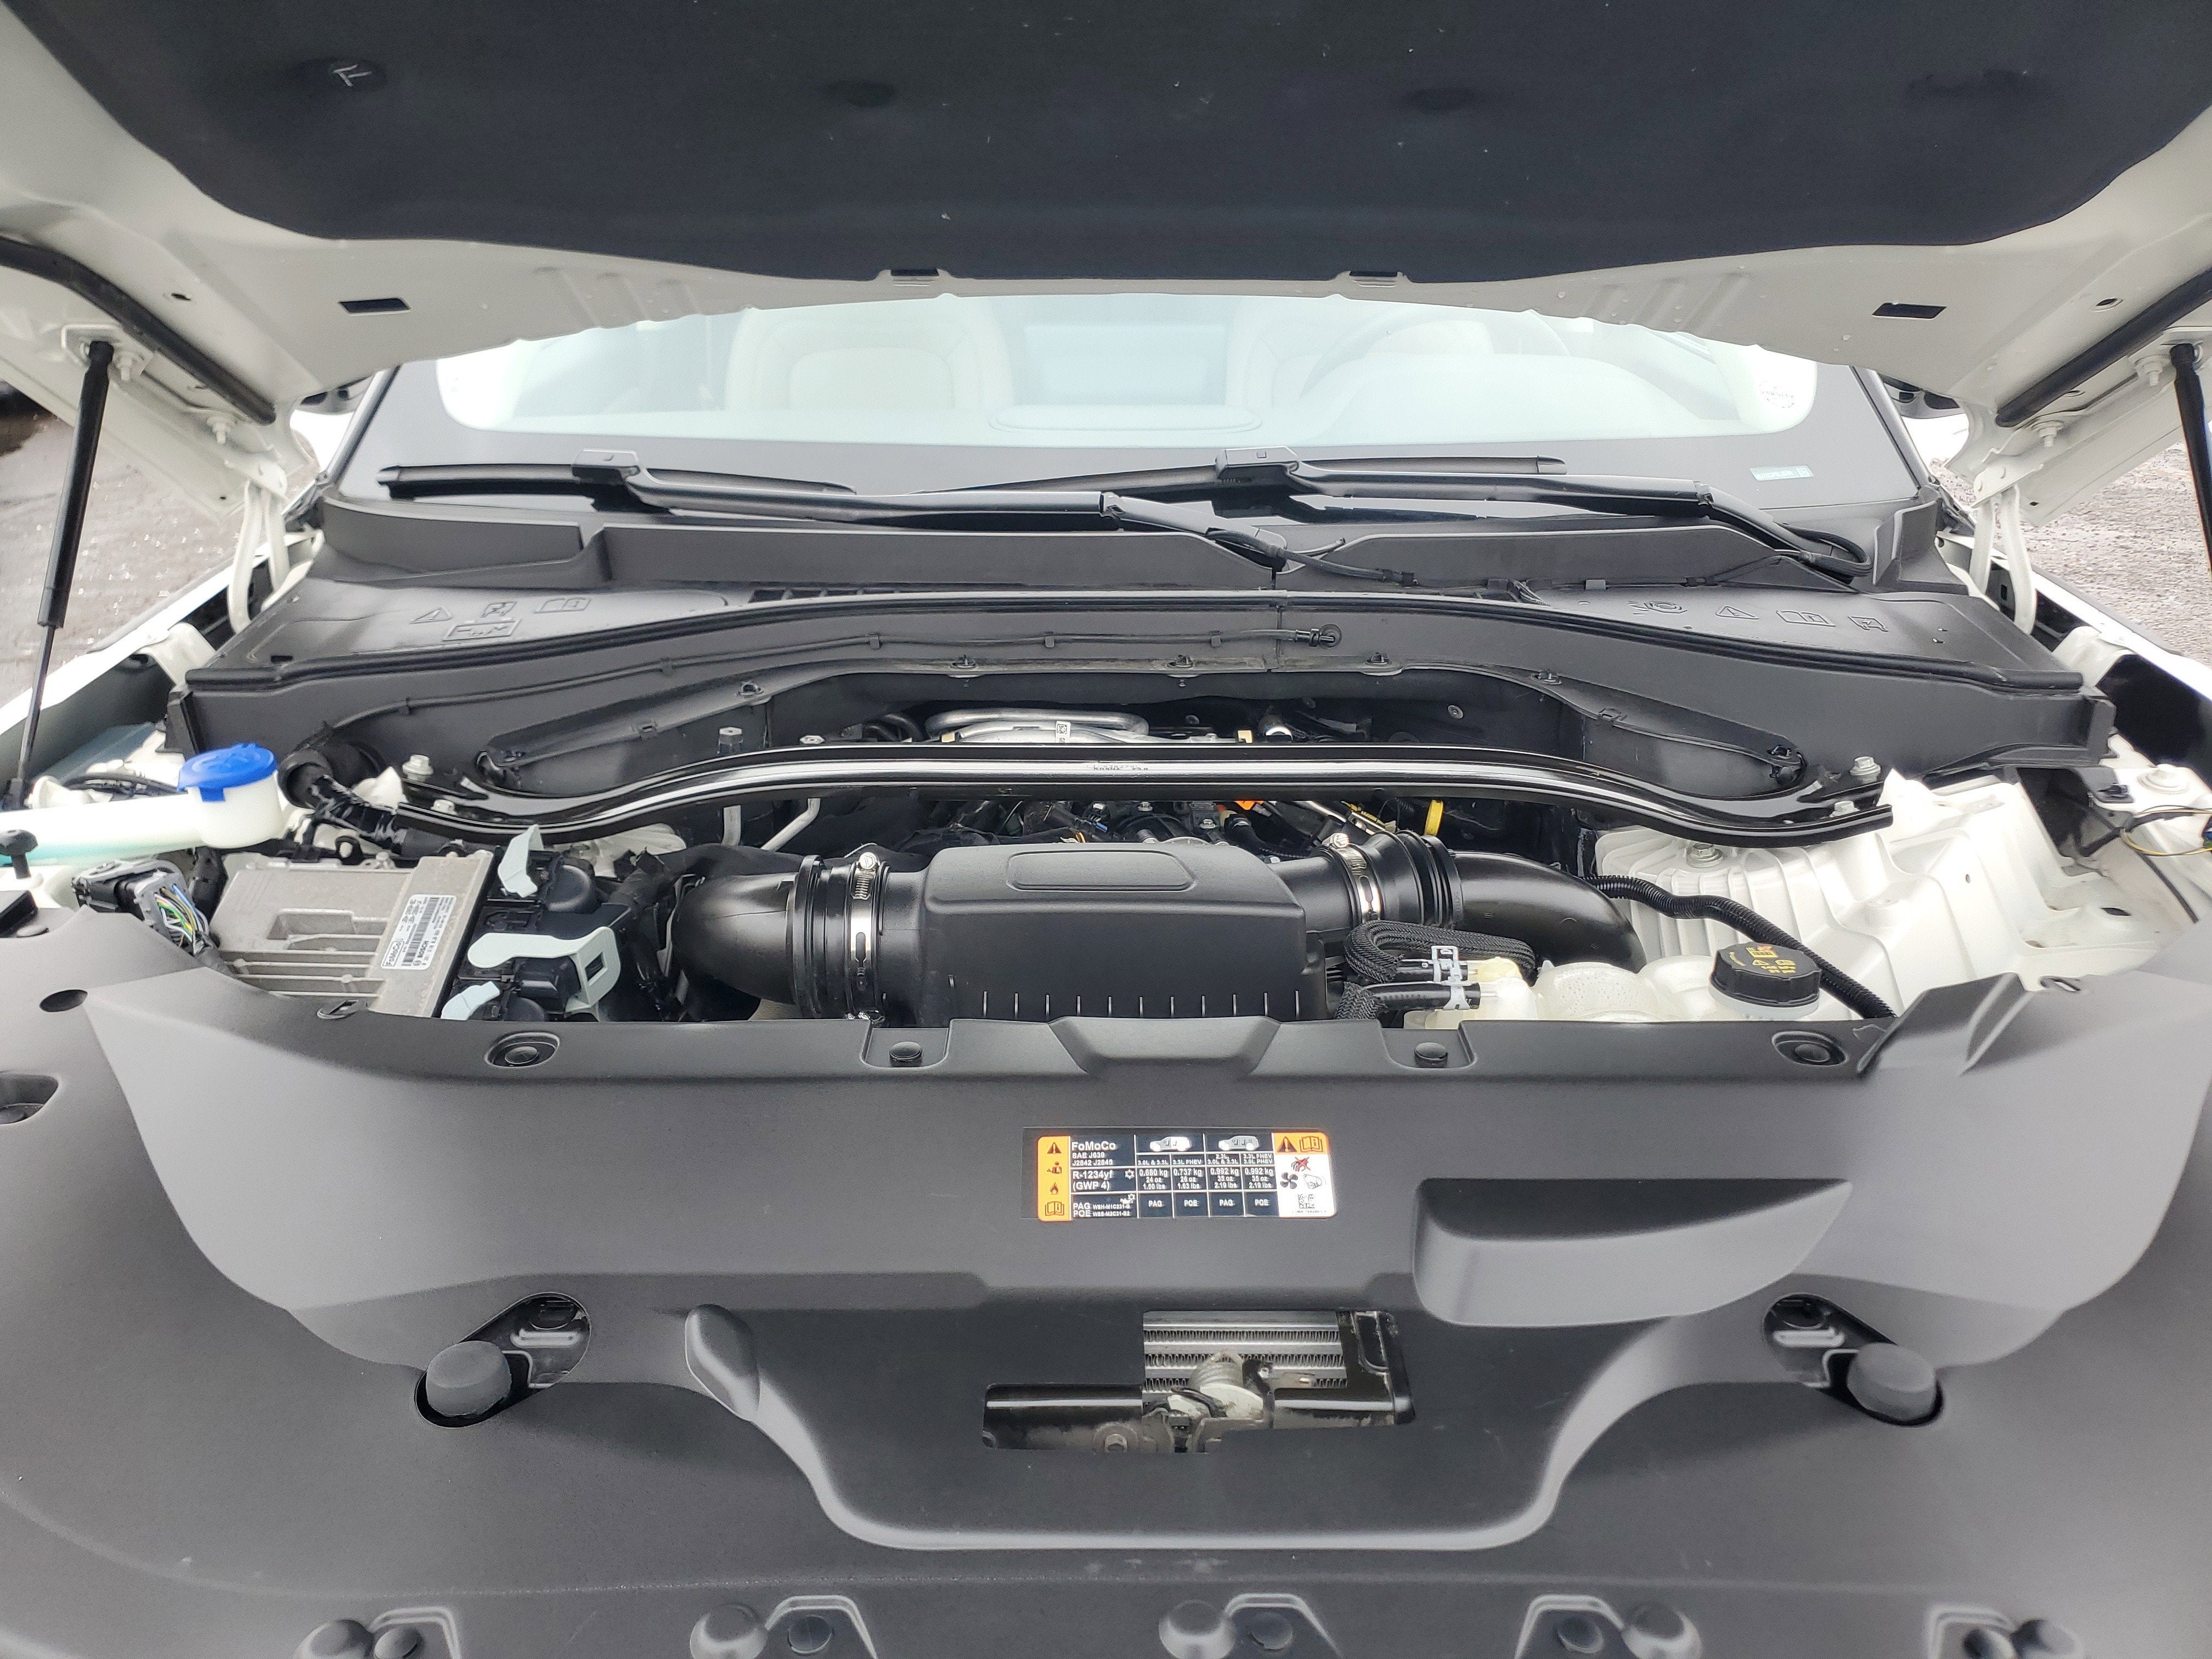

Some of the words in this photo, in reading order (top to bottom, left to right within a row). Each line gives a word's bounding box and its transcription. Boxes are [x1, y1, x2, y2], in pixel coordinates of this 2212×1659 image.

[1071, 1141, 1116, 1151] FoMoCo
[1073, 1170, 1113, 1180] R-1234yf
[1159, 1169, 1168, 1177] kg
[1193, 1168, 1202, 1177] kg
[1231, 1167, 1239, 1176] kg
[1265, 1167, 1273, 1176] kg
[1073, 1181, 1098, 1192] (GWP
[1101, 1181, 1110, 1190] 4)
